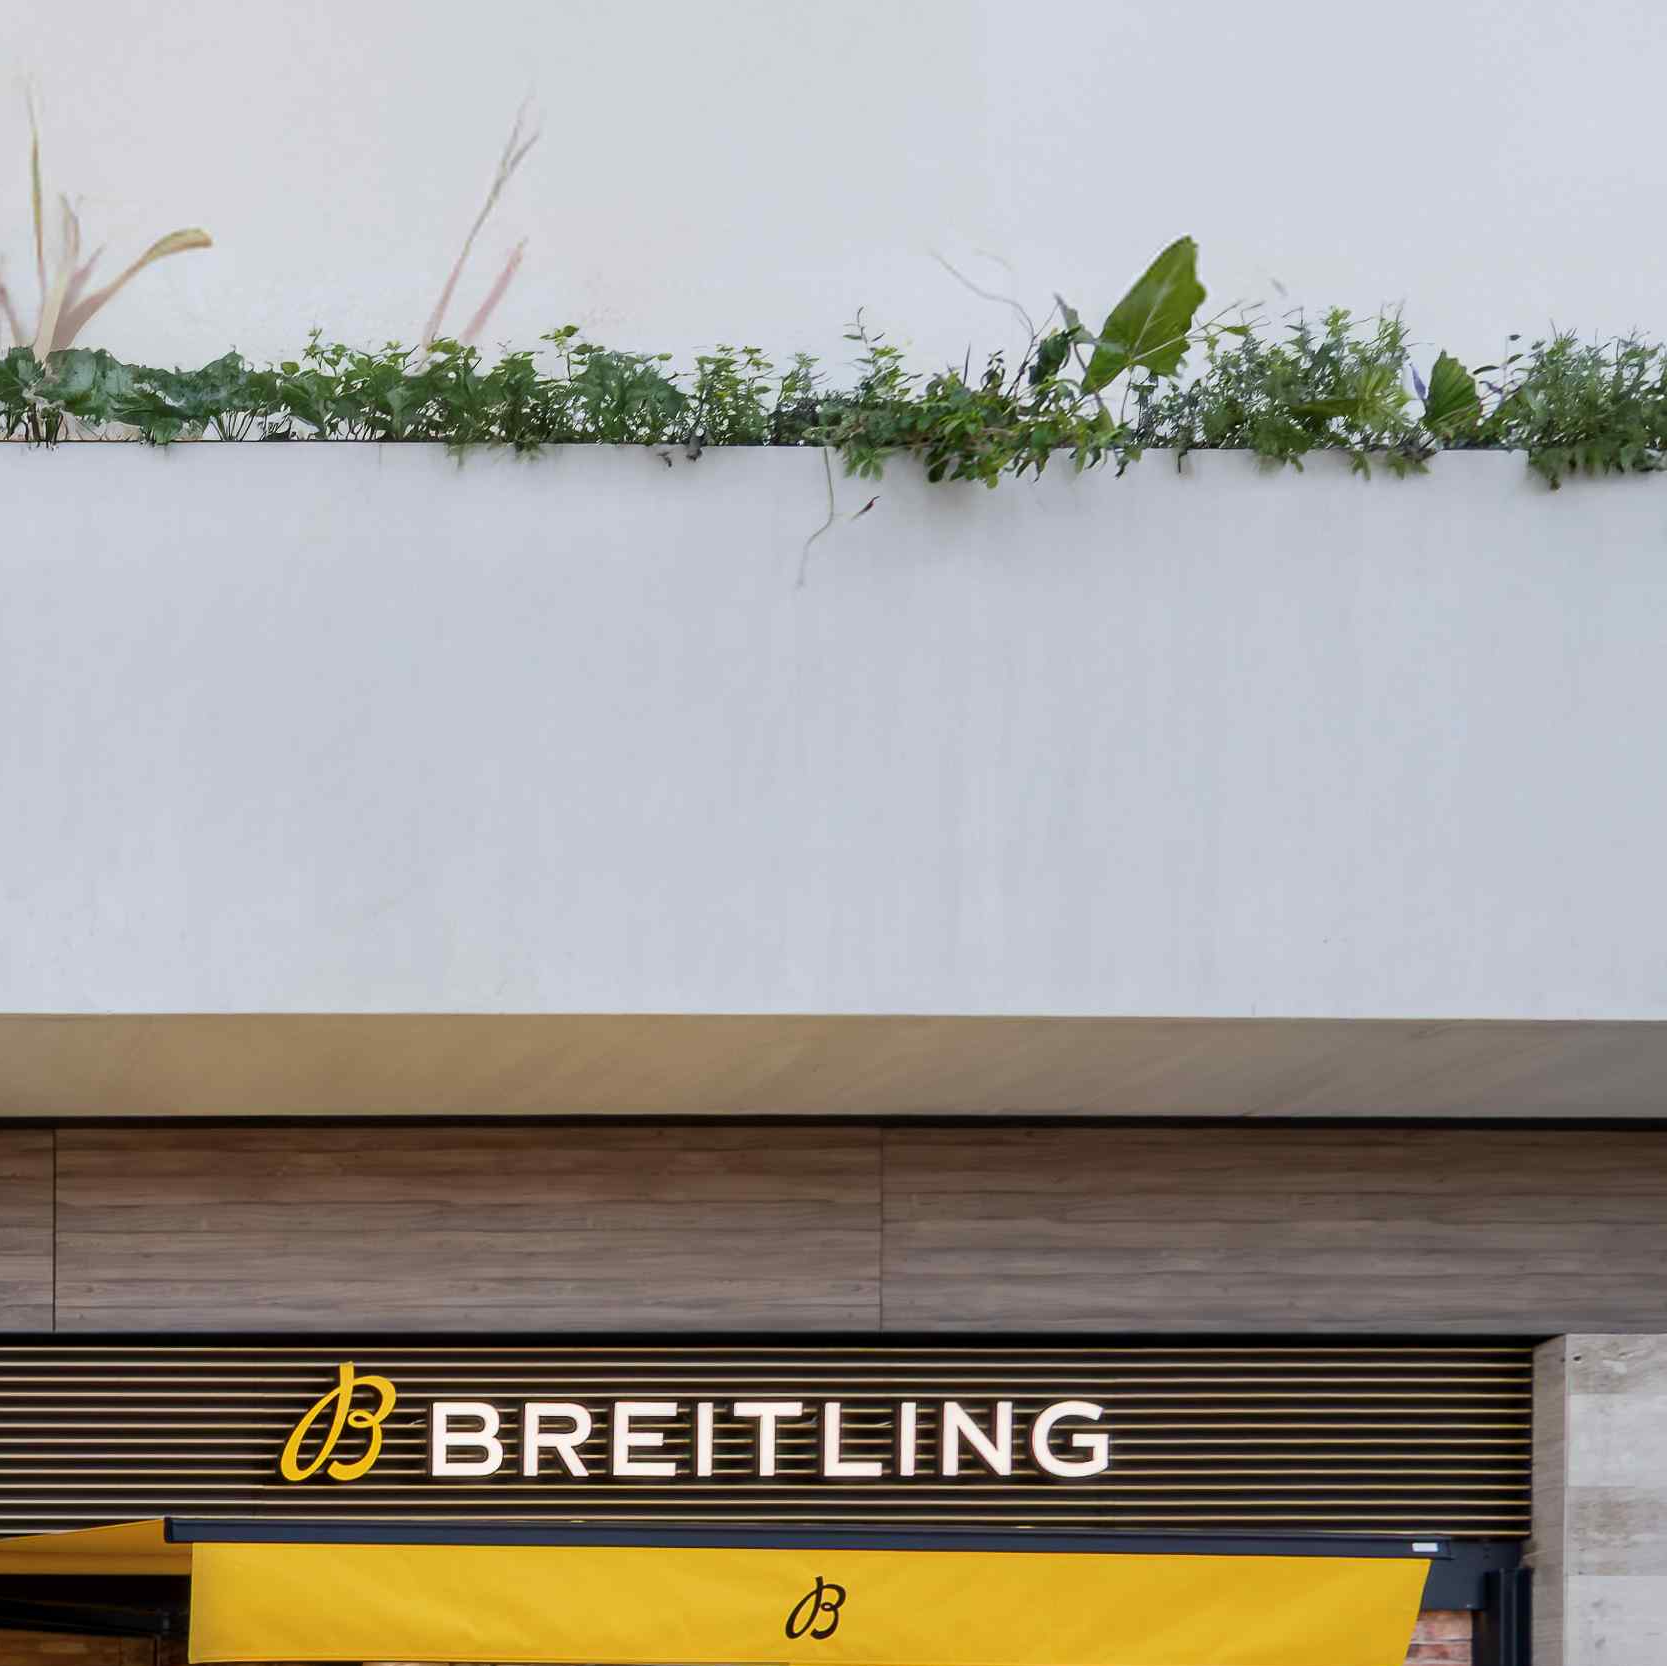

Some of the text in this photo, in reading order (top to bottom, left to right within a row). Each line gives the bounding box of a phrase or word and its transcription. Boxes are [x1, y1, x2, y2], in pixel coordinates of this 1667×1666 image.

[279, 1361, 1110, 1482] B BREITLING
[785, 1575, 847, 1640] B
